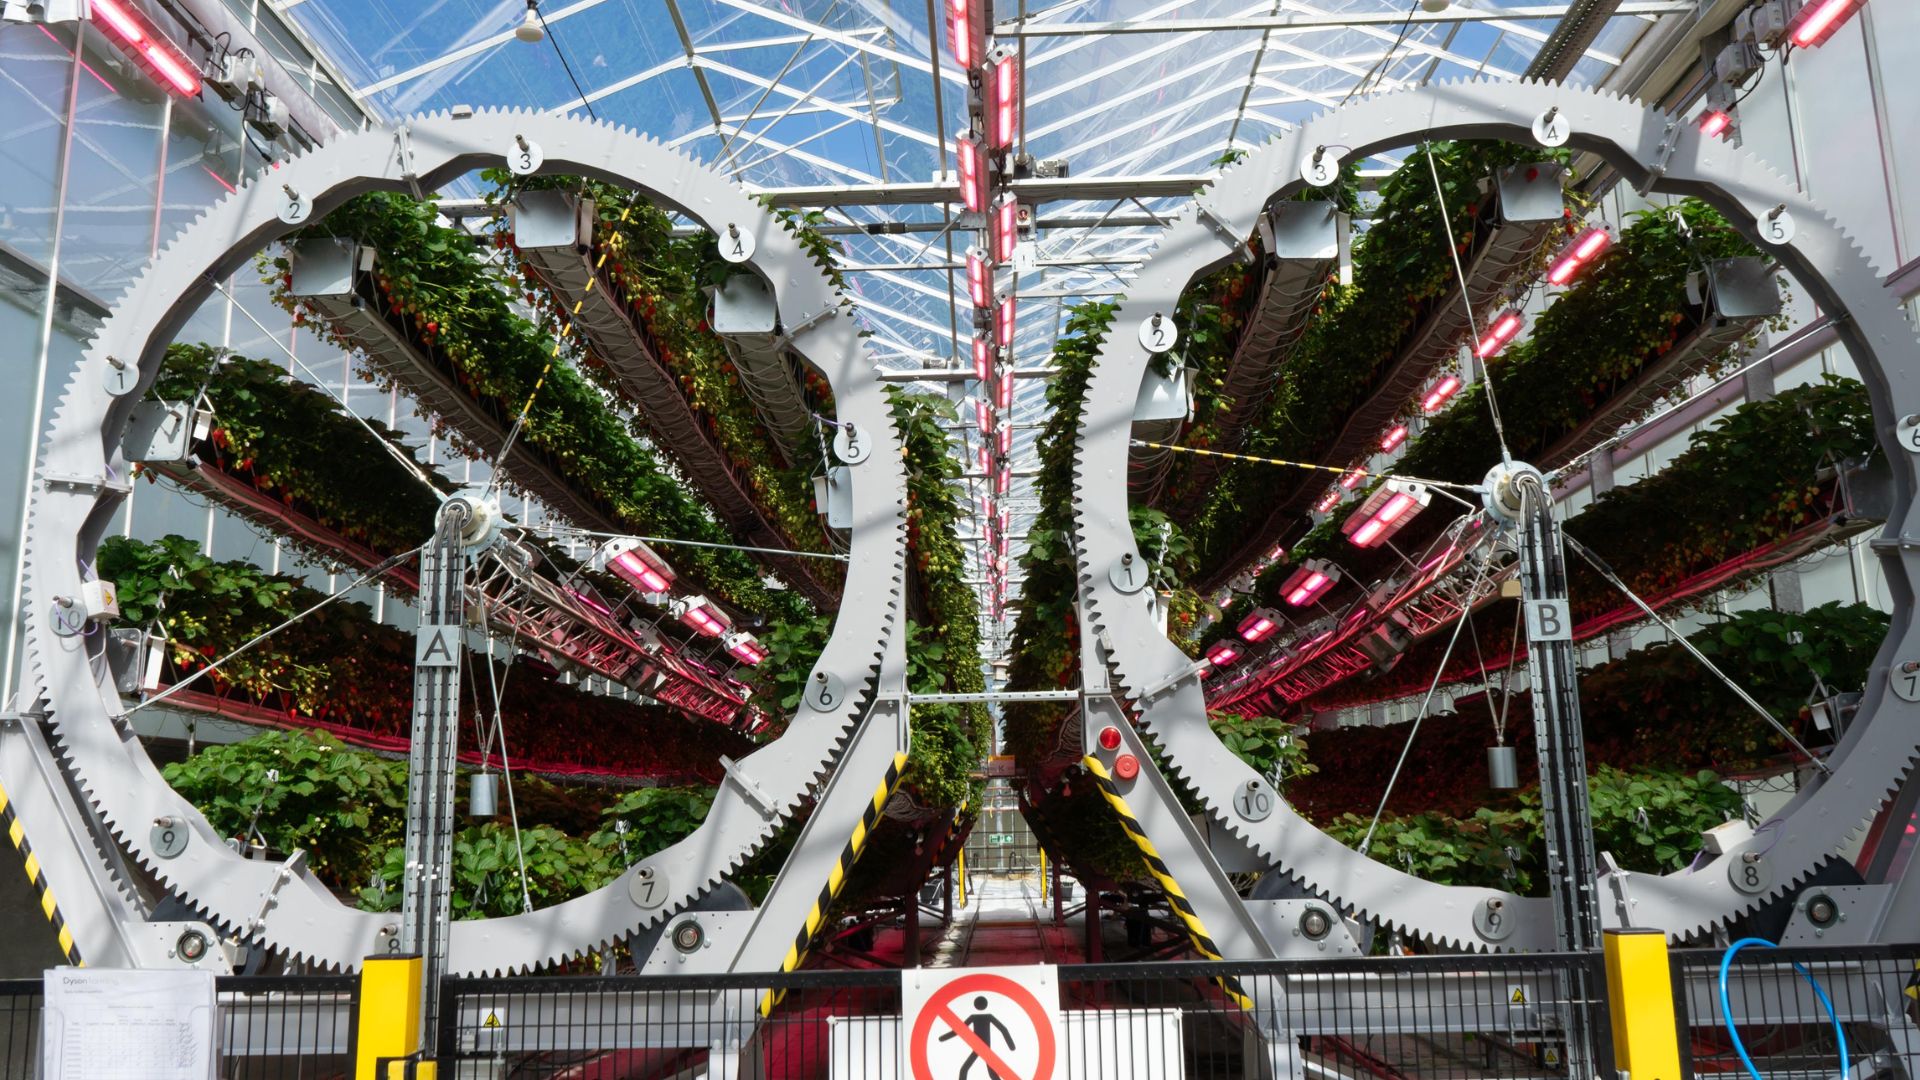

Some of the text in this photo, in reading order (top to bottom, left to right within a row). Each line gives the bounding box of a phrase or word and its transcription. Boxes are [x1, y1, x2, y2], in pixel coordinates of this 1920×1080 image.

[1547, 126, 1559, 140] 4
[520, 153, 531, 170] 3
[1315, 165, 1327, 181] 3
[287, 204, 300, 219] 2
[1773, 222, 1784, 239] 5
[732, 240, 745, 258] 4
[1153, 330, 1165, 347] 2
[117, 373, 124, 390] 1
[1912, 429, 1920, 447] 6
[848, 440, 860, 459] 5
[1126, 569, 1133, 586] 1
[56, 611, 80, 631] 10
[1538, 604, 1560, 636] B
[423, 631, 451, 661] A
[1904, 676, 1916, 696] 7
[819, 687, 833, 705] 6
[1241, 794, 1270, 815] 10
[162, 832, 175, 851] 9
[1745, 867, 1759, 886] 8
[641, 881, 655, 902] 7
[1490, 912, 1501, 932] 9
[388, 938, 401, 954] 8
[62, 977, 88, 987] Dyson
